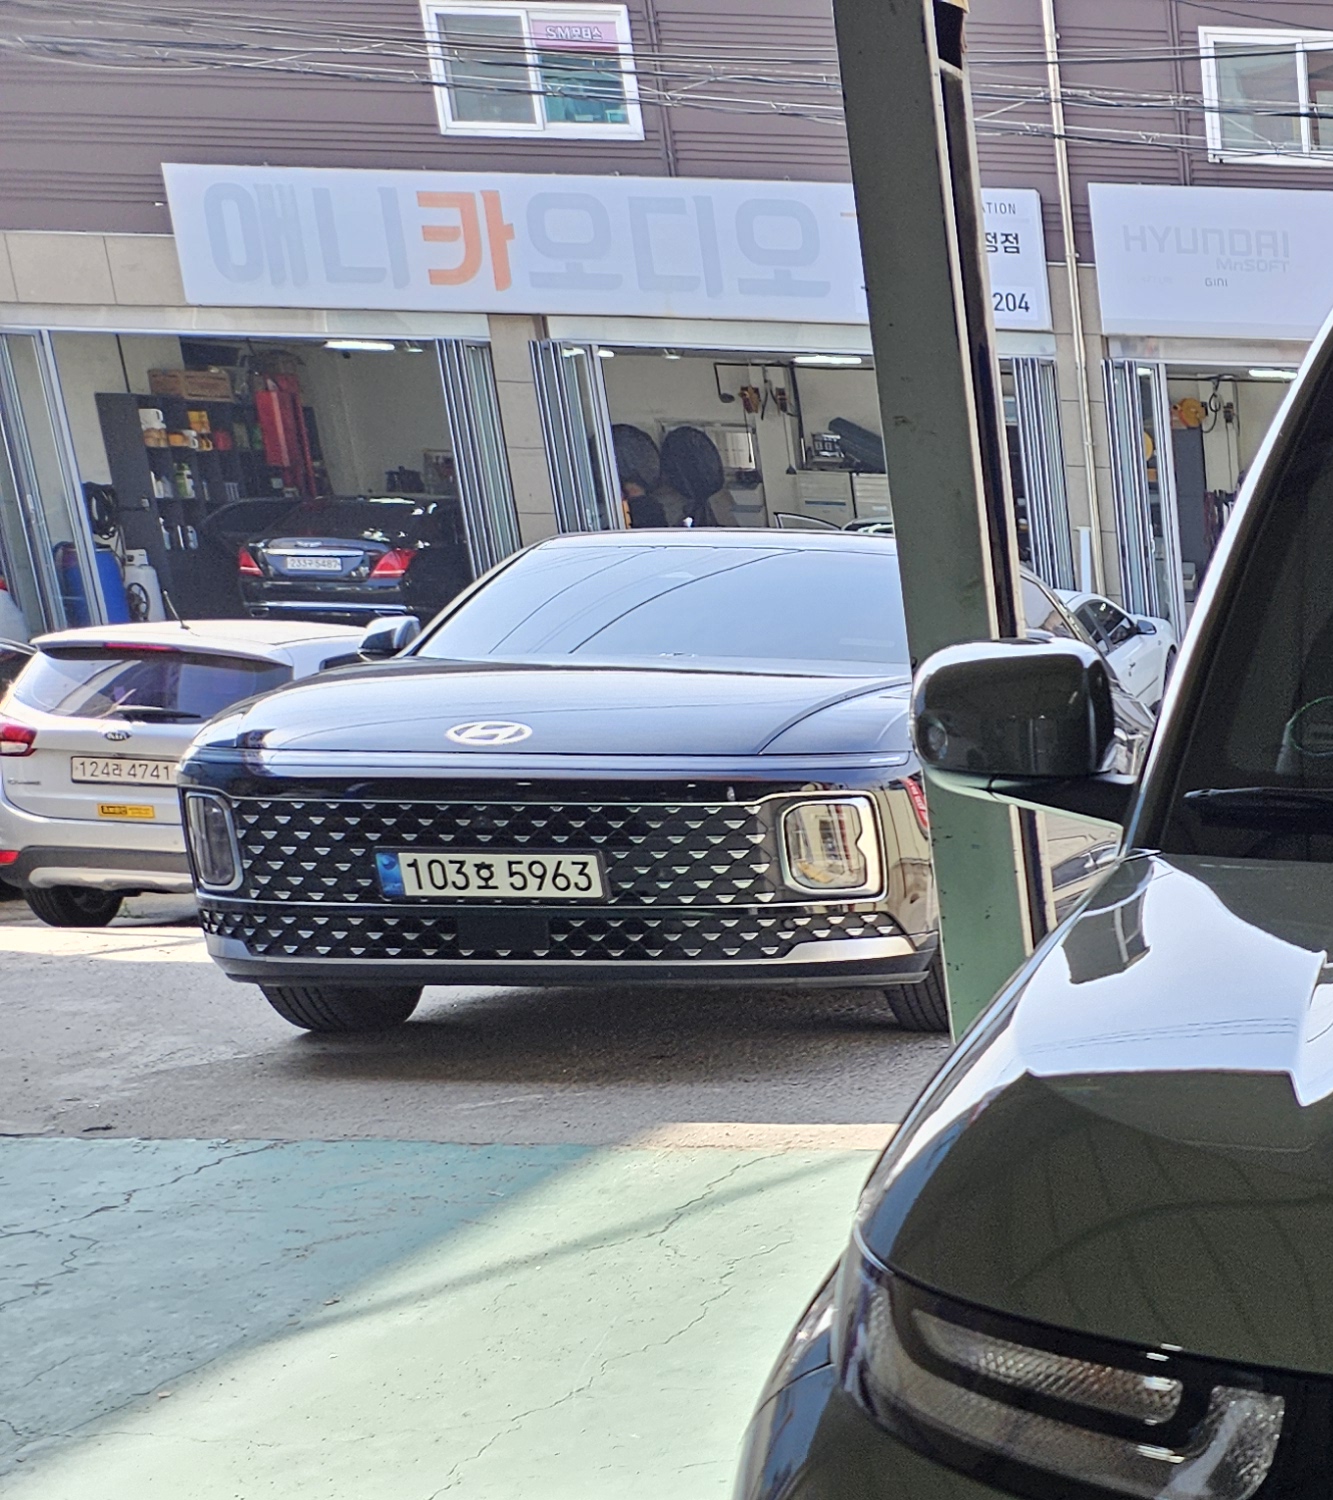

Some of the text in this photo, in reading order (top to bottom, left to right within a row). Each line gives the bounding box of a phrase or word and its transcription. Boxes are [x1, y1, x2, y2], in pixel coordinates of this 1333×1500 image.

[1122, 224, 1290, 258] HYUNDAI
[127, 763, 170, 780] 4741
[407, 858, 593, 892] 103호 5963
